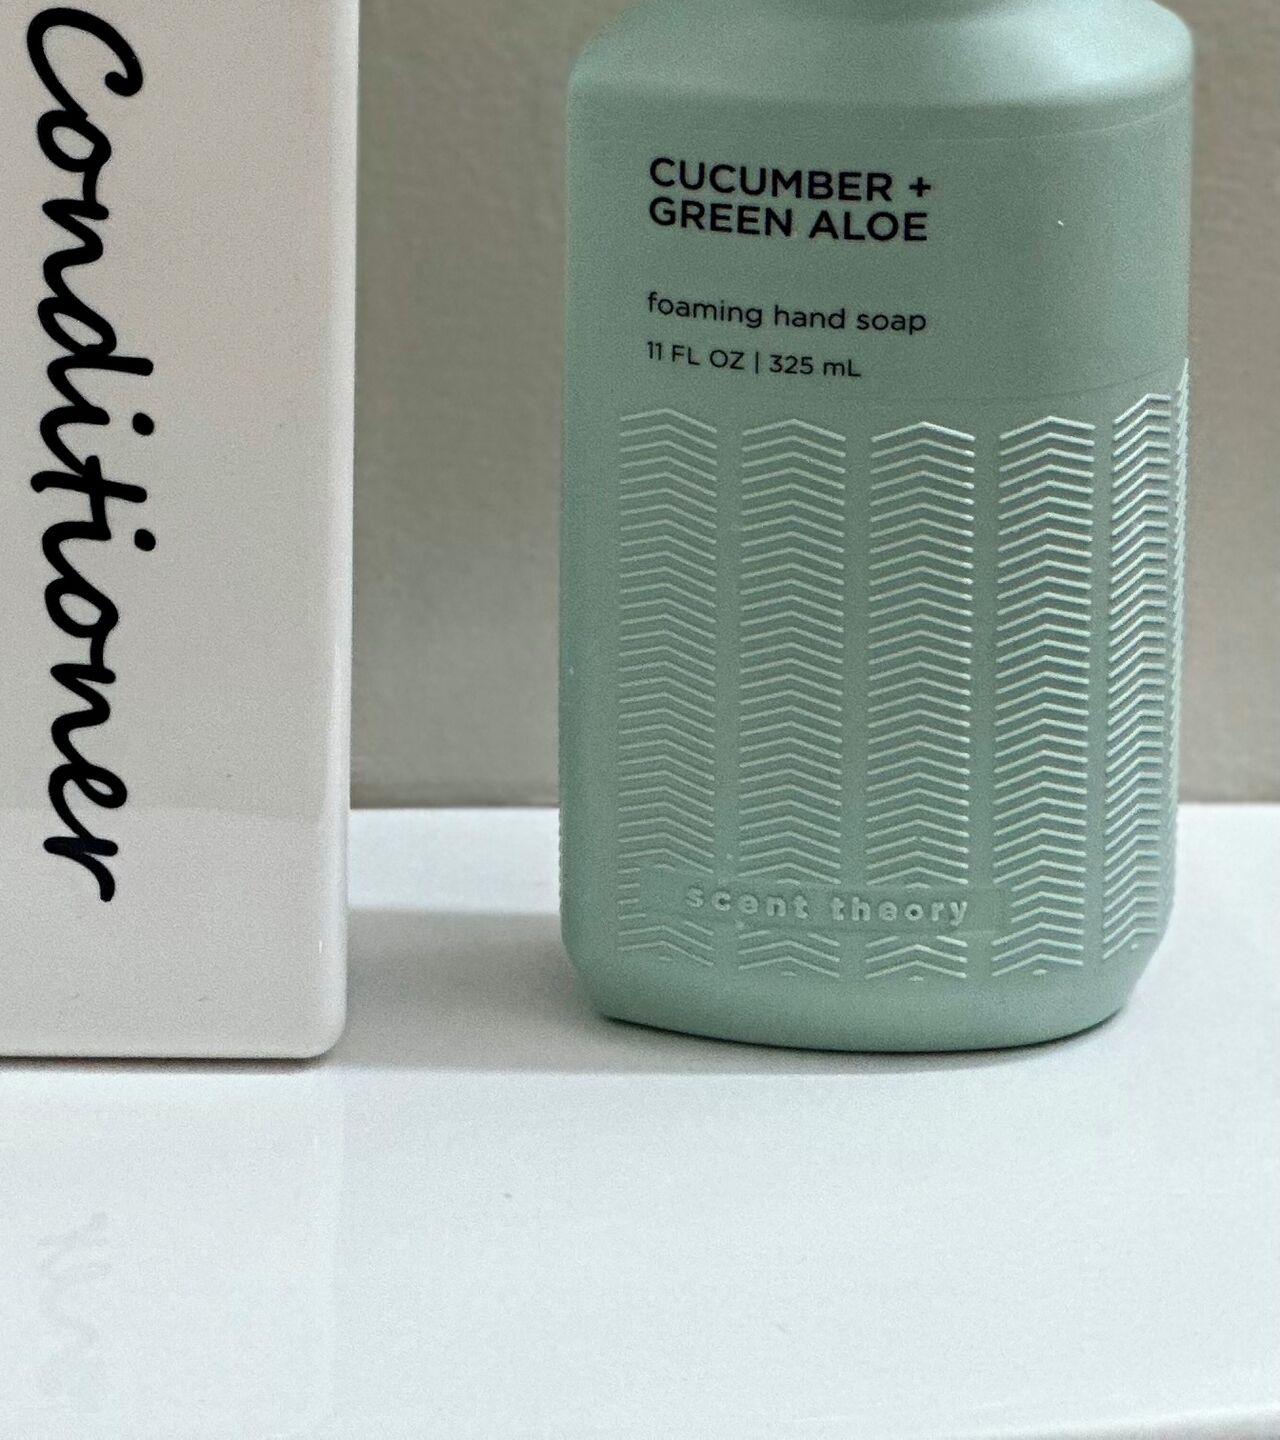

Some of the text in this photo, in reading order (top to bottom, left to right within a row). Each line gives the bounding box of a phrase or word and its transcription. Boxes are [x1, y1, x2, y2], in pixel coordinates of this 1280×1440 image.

[648, 156, 932, 203] CUCUMBER +
[648, 195, 929, 243] GREEN ALOE
[647, 290, 927, 336] foaming hand soap
[647, 340, 663, 361] 11
[671, 344, 701, 366] FL
[709, 348, 745, 371] OZ
[768, 353, 815, 376] 325
[822, 357, 862, 378] mL
[25, 6, 156, 903] Conditioner
[685, 883, 969, 925] scent theory
